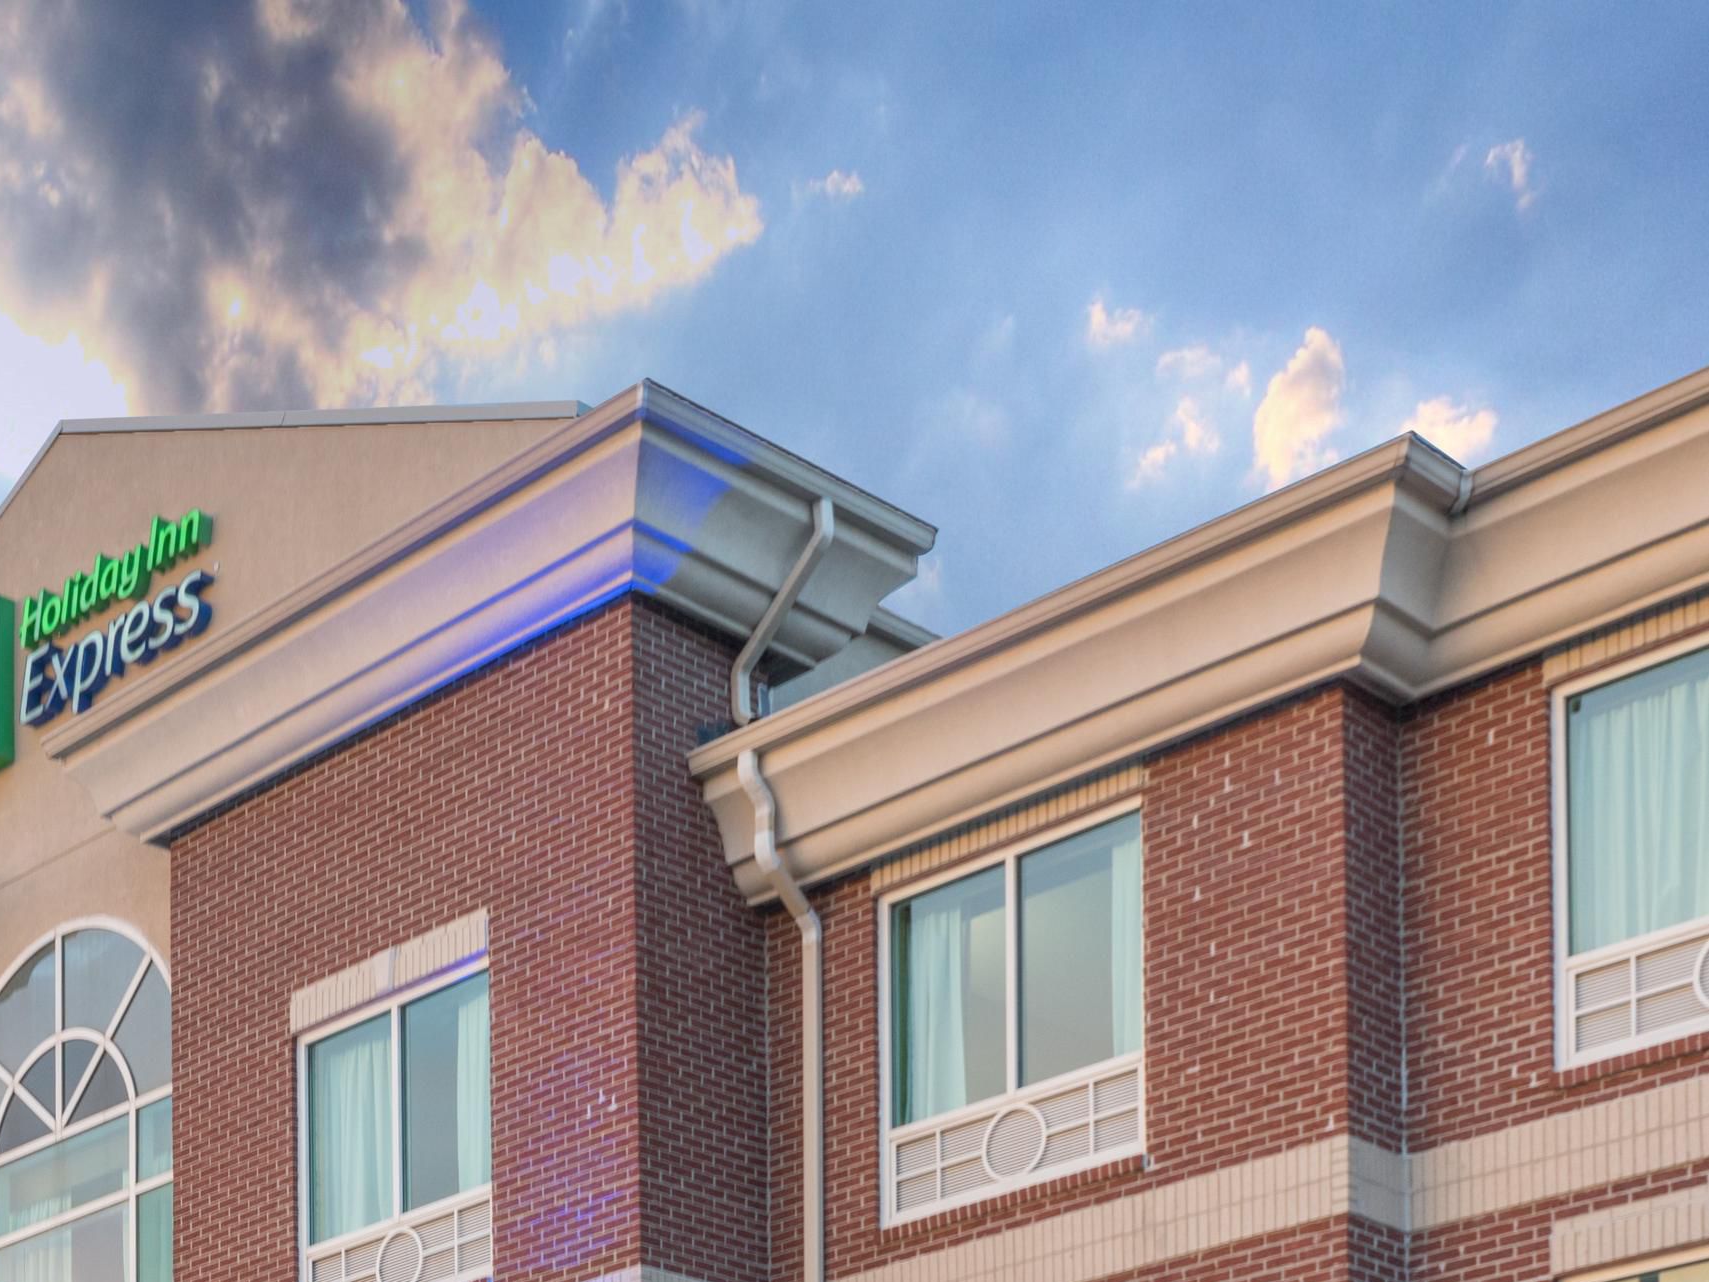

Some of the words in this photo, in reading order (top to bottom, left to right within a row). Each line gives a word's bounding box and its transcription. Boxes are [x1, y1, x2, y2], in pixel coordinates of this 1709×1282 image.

[20, 543, 149, 648] Holiday
[147, 508, 203, 573] Inn
[20, 569, 208, 727] Express
